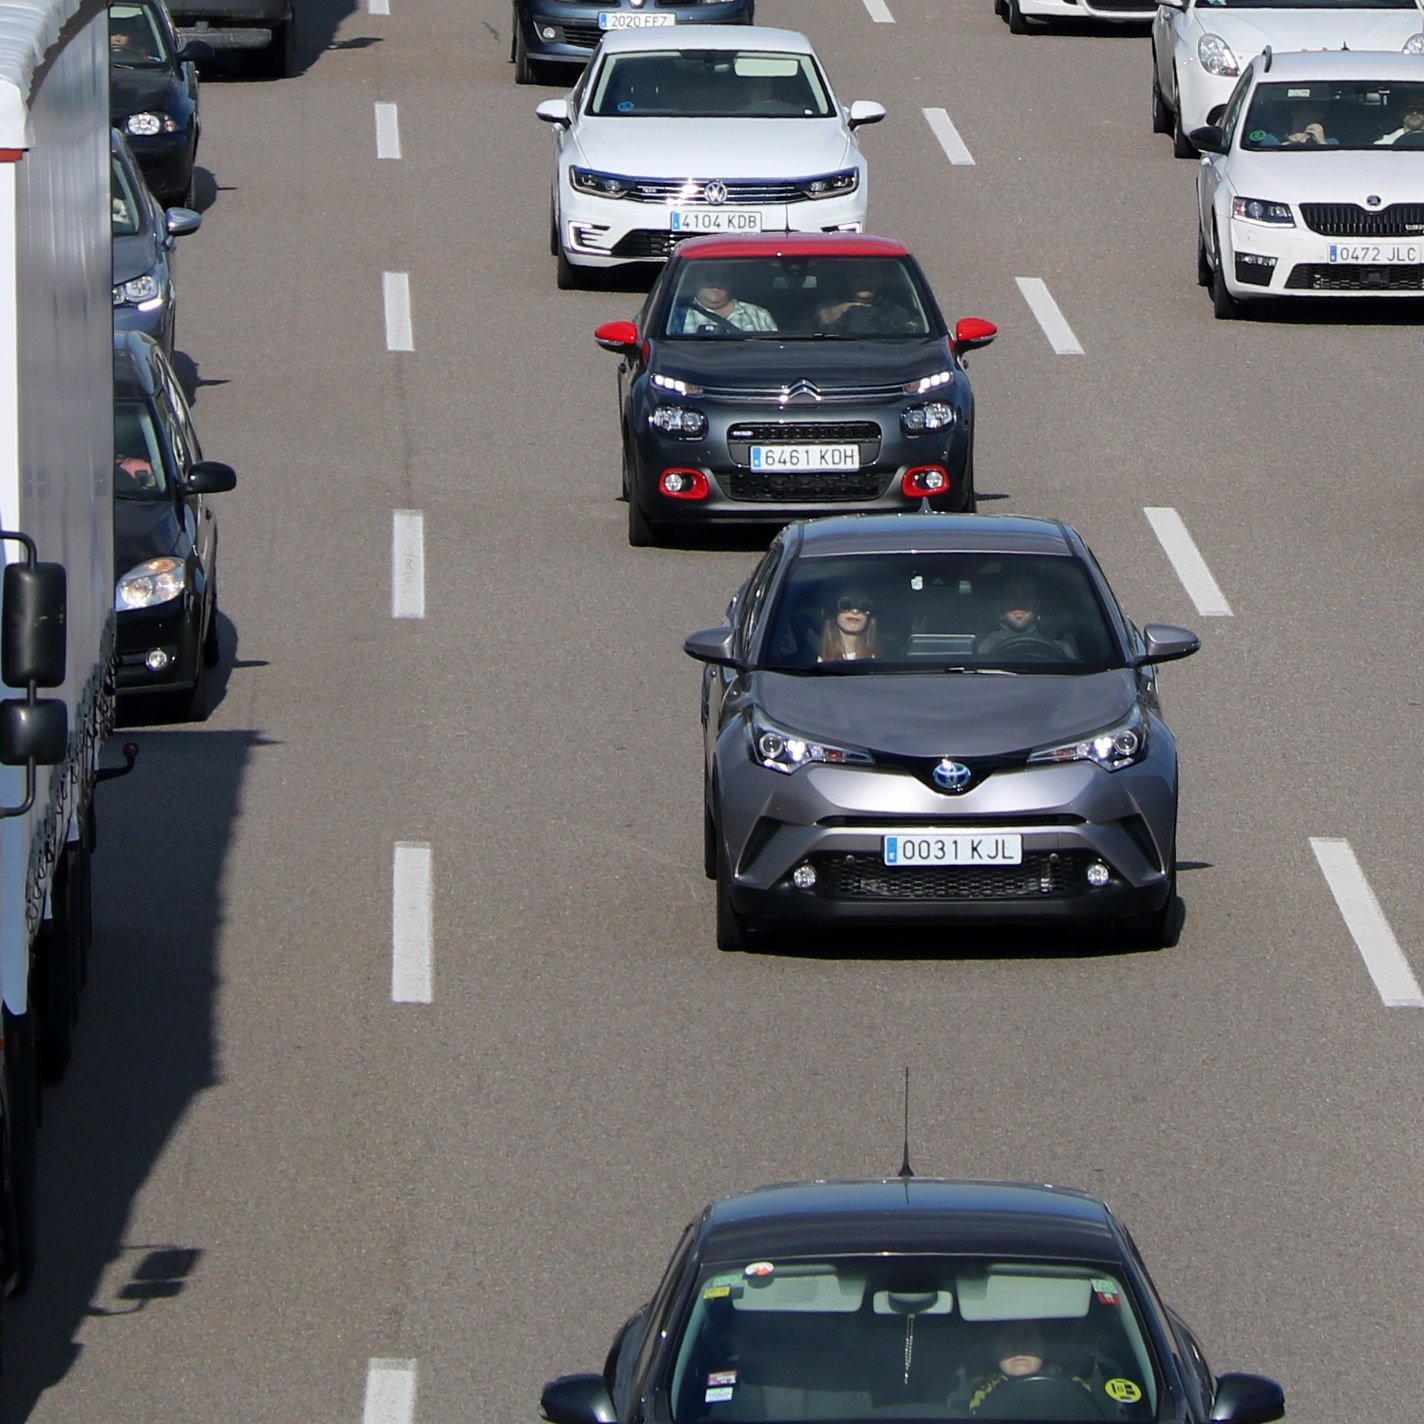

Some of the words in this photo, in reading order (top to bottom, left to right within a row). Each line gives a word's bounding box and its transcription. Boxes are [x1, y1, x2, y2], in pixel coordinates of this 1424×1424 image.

[611, 15, 641, 28] 2020
[682, 214, 721, 228] 4104
[727, 214, 757, 228] KDB
[1340, 246, 1381, 262] 0472
[1386, 246, 1417, 262] JLC
[764, 449, 810, 466] 6461
[819, 448, 855, 466] KDH
[902, 839, 958, 860] 0031
[970, 838, 1015, 860] KJL
